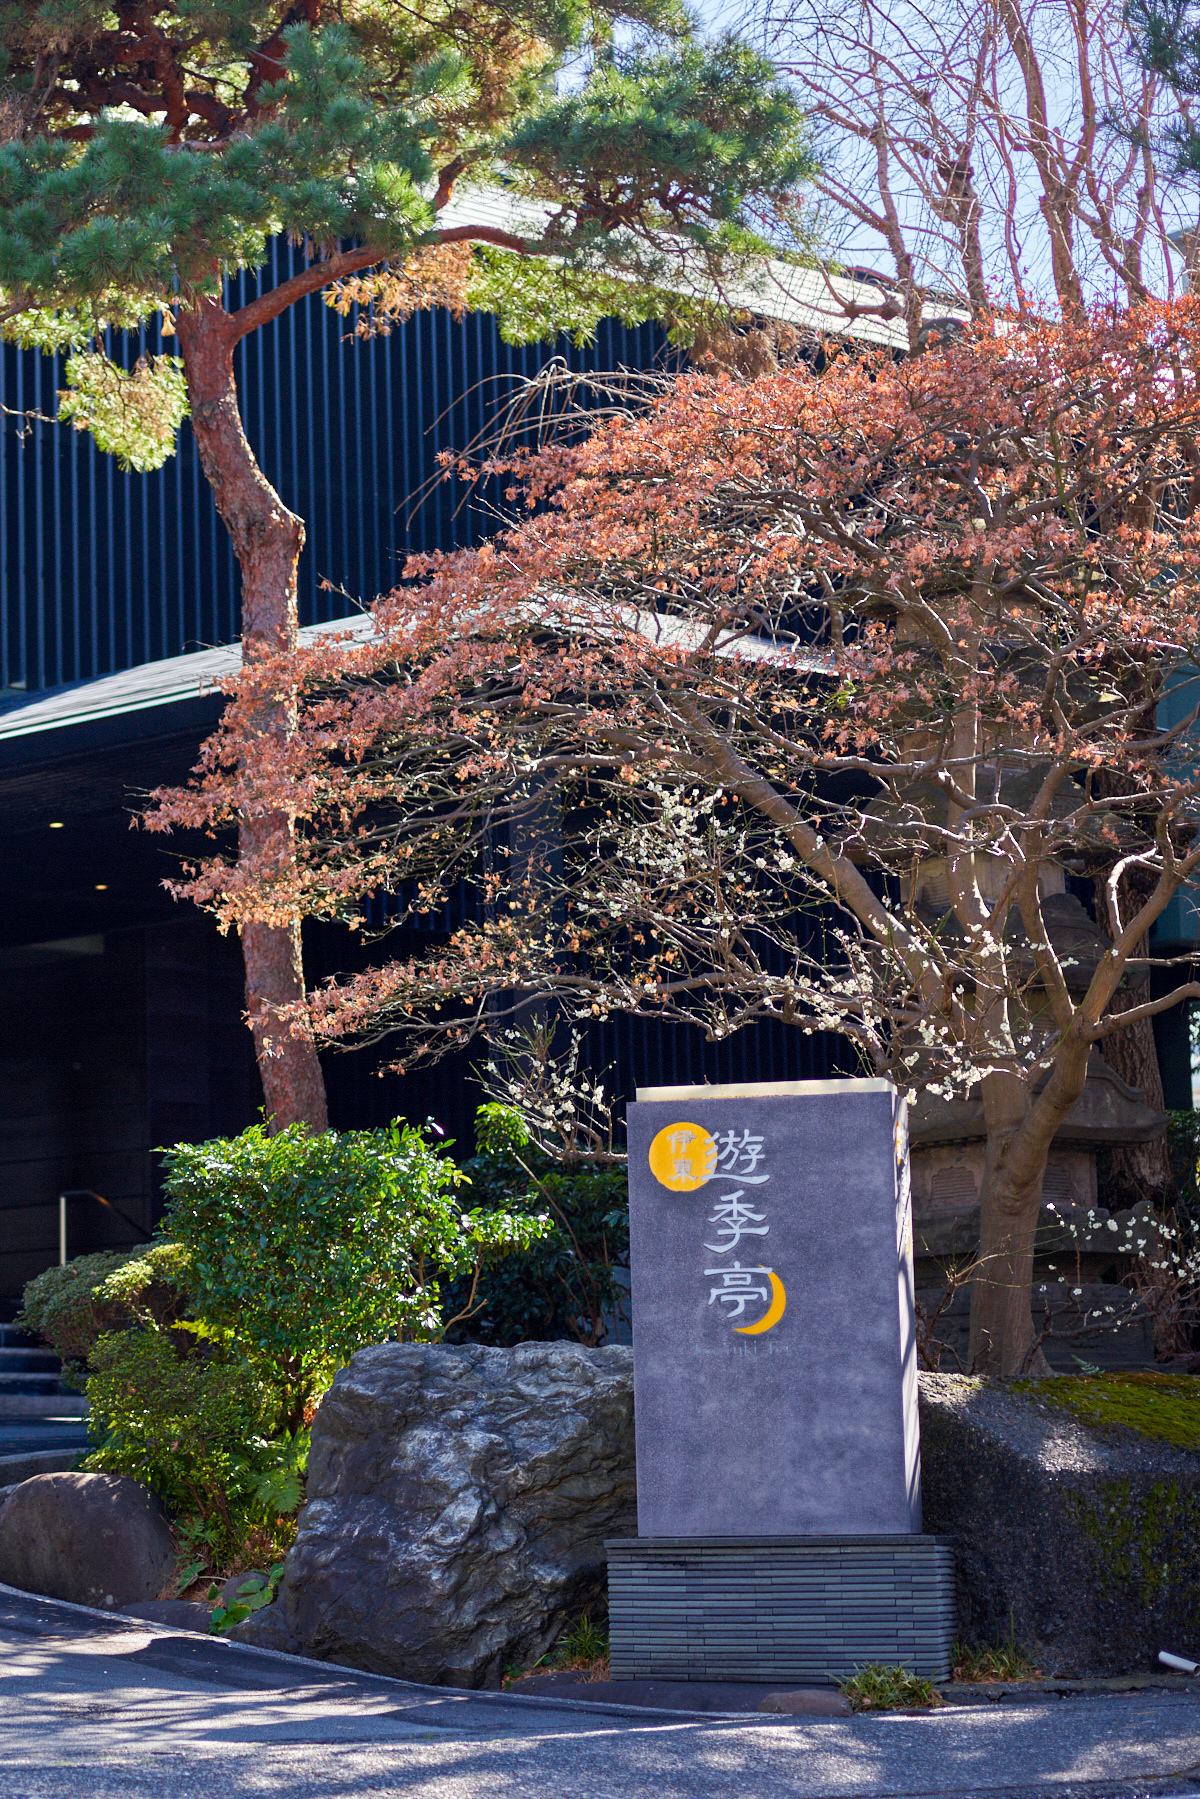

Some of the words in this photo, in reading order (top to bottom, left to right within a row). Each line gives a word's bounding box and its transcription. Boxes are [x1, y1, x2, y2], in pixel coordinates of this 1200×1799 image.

[667, 1130, 698, 1183] 伊東
[701, 1128, 773, 1318] 遊季亭
